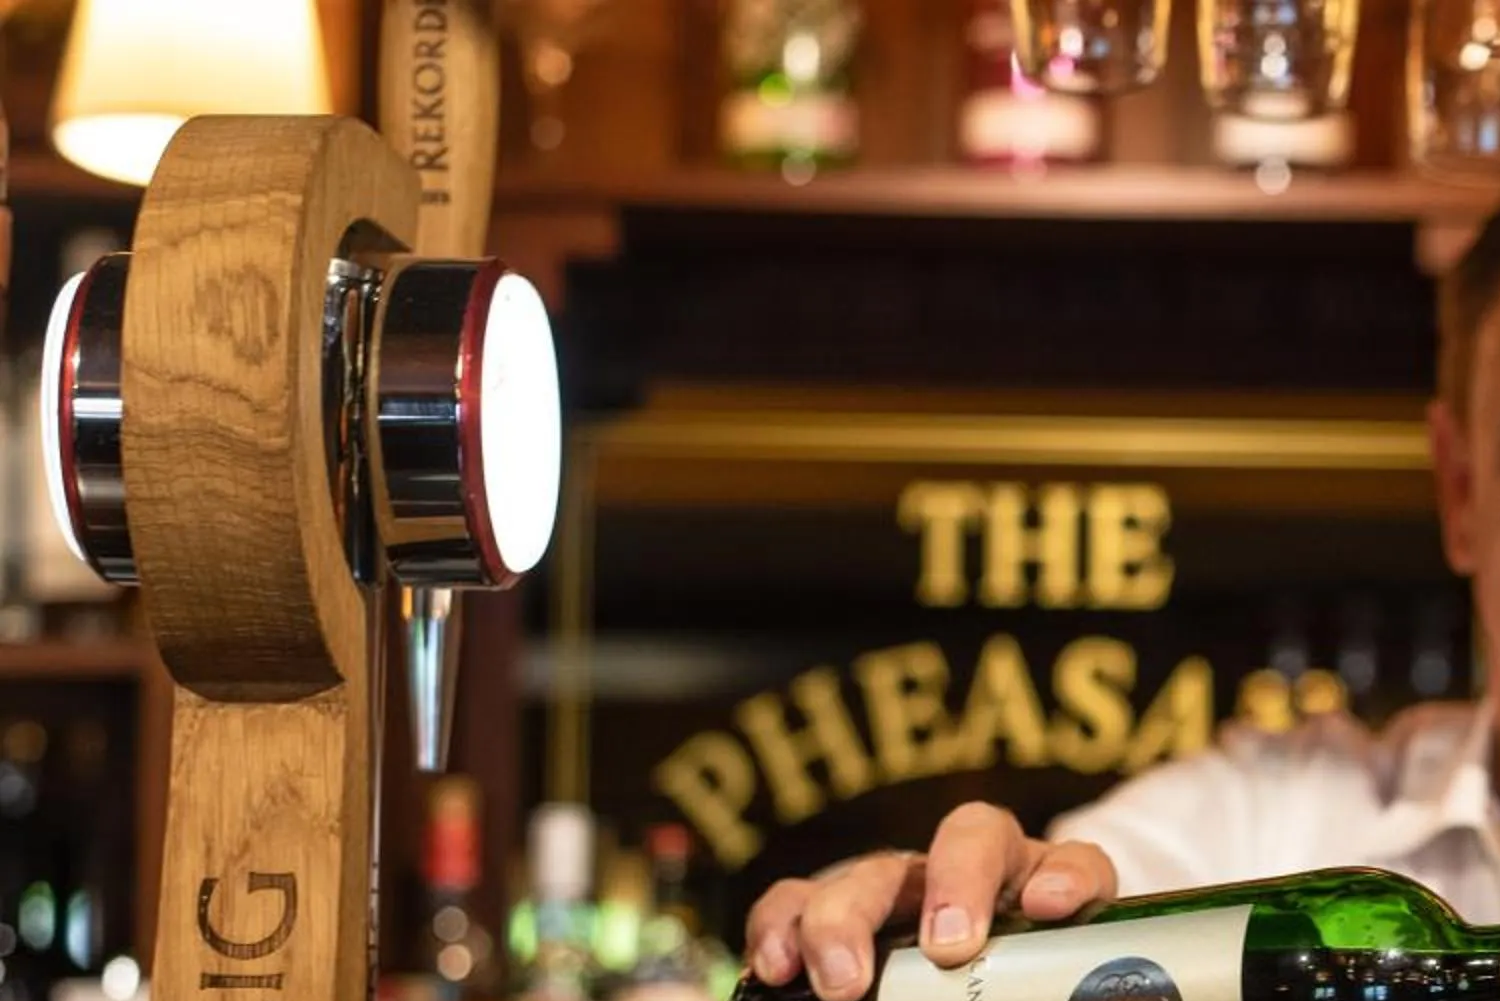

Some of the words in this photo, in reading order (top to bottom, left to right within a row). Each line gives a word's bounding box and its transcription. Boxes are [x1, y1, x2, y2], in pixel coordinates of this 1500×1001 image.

[410, 0, 449, 172] REKORD
[898, 480, 1176, 610] THE
[654, 632, 1348, 870] PHEASA
